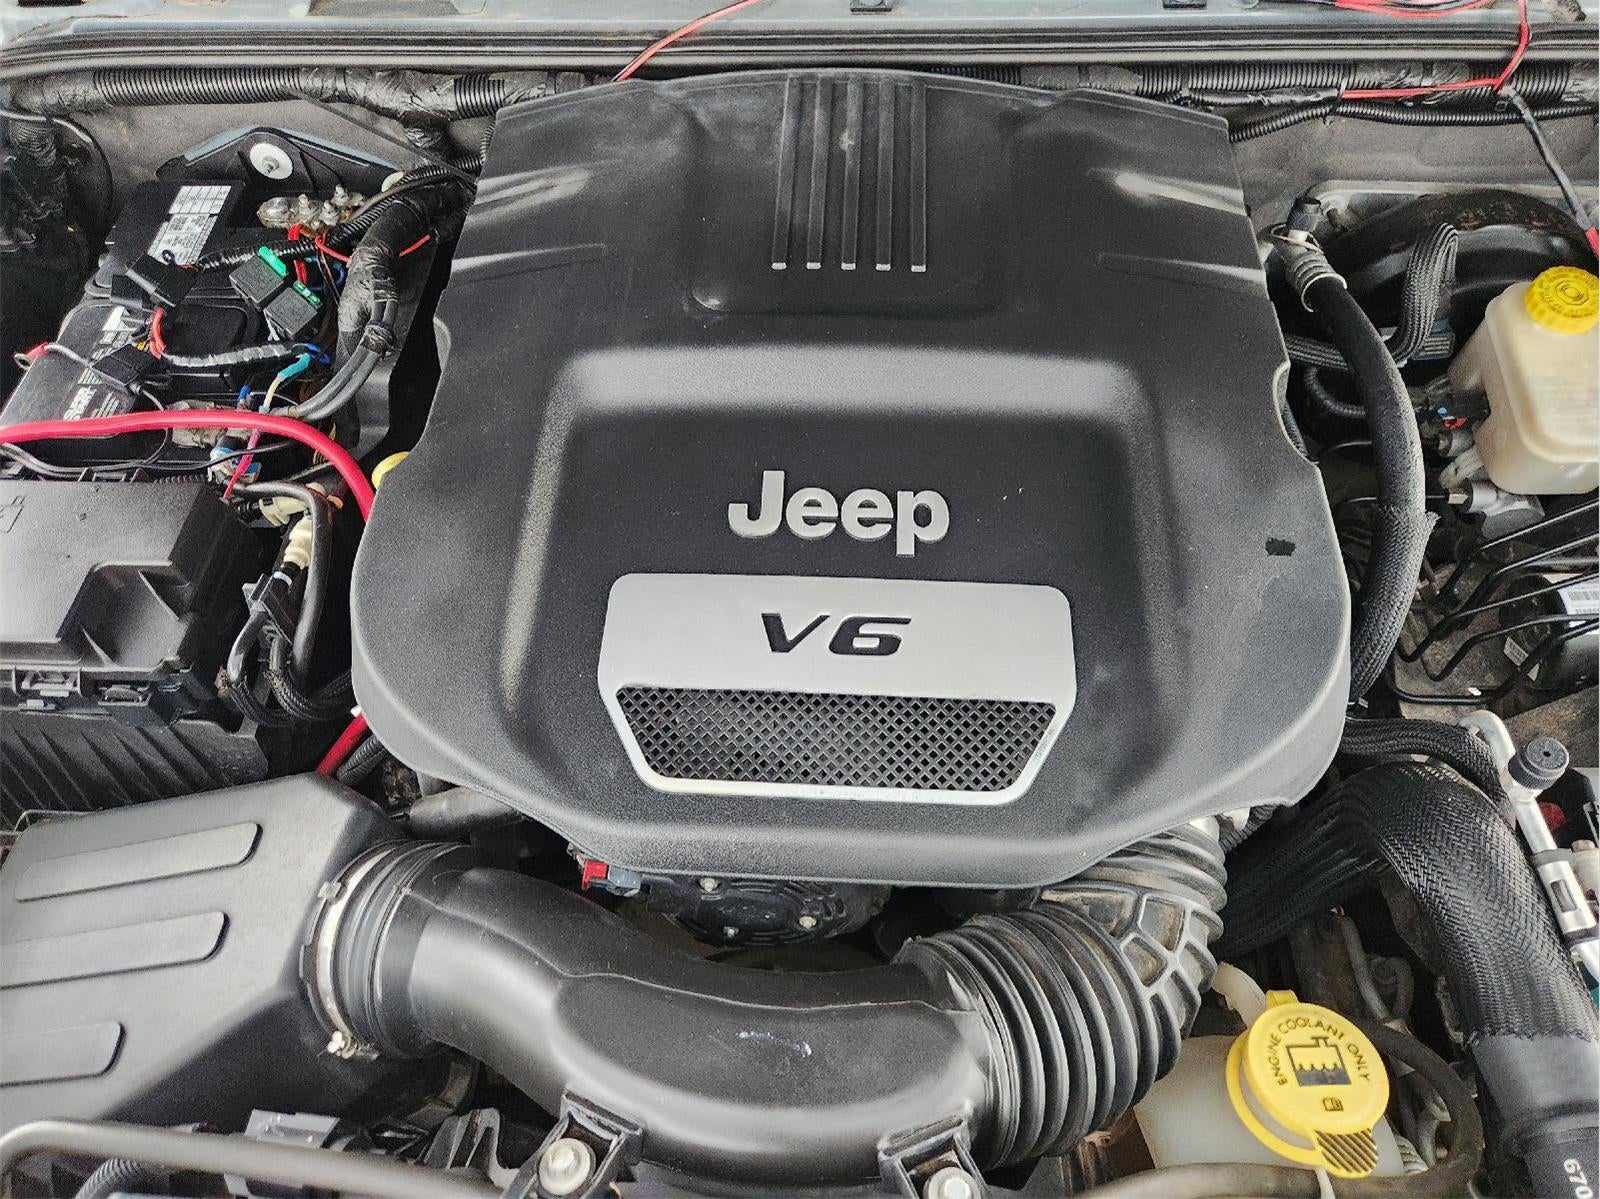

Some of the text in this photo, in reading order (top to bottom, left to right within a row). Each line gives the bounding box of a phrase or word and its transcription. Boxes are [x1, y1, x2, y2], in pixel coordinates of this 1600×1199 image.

[728, 470, 949, 557] Jeep
[761, 612, 912, 656] V6
[1268, 1017, 1371, 1086] ENGINE COOLANT ONLY
